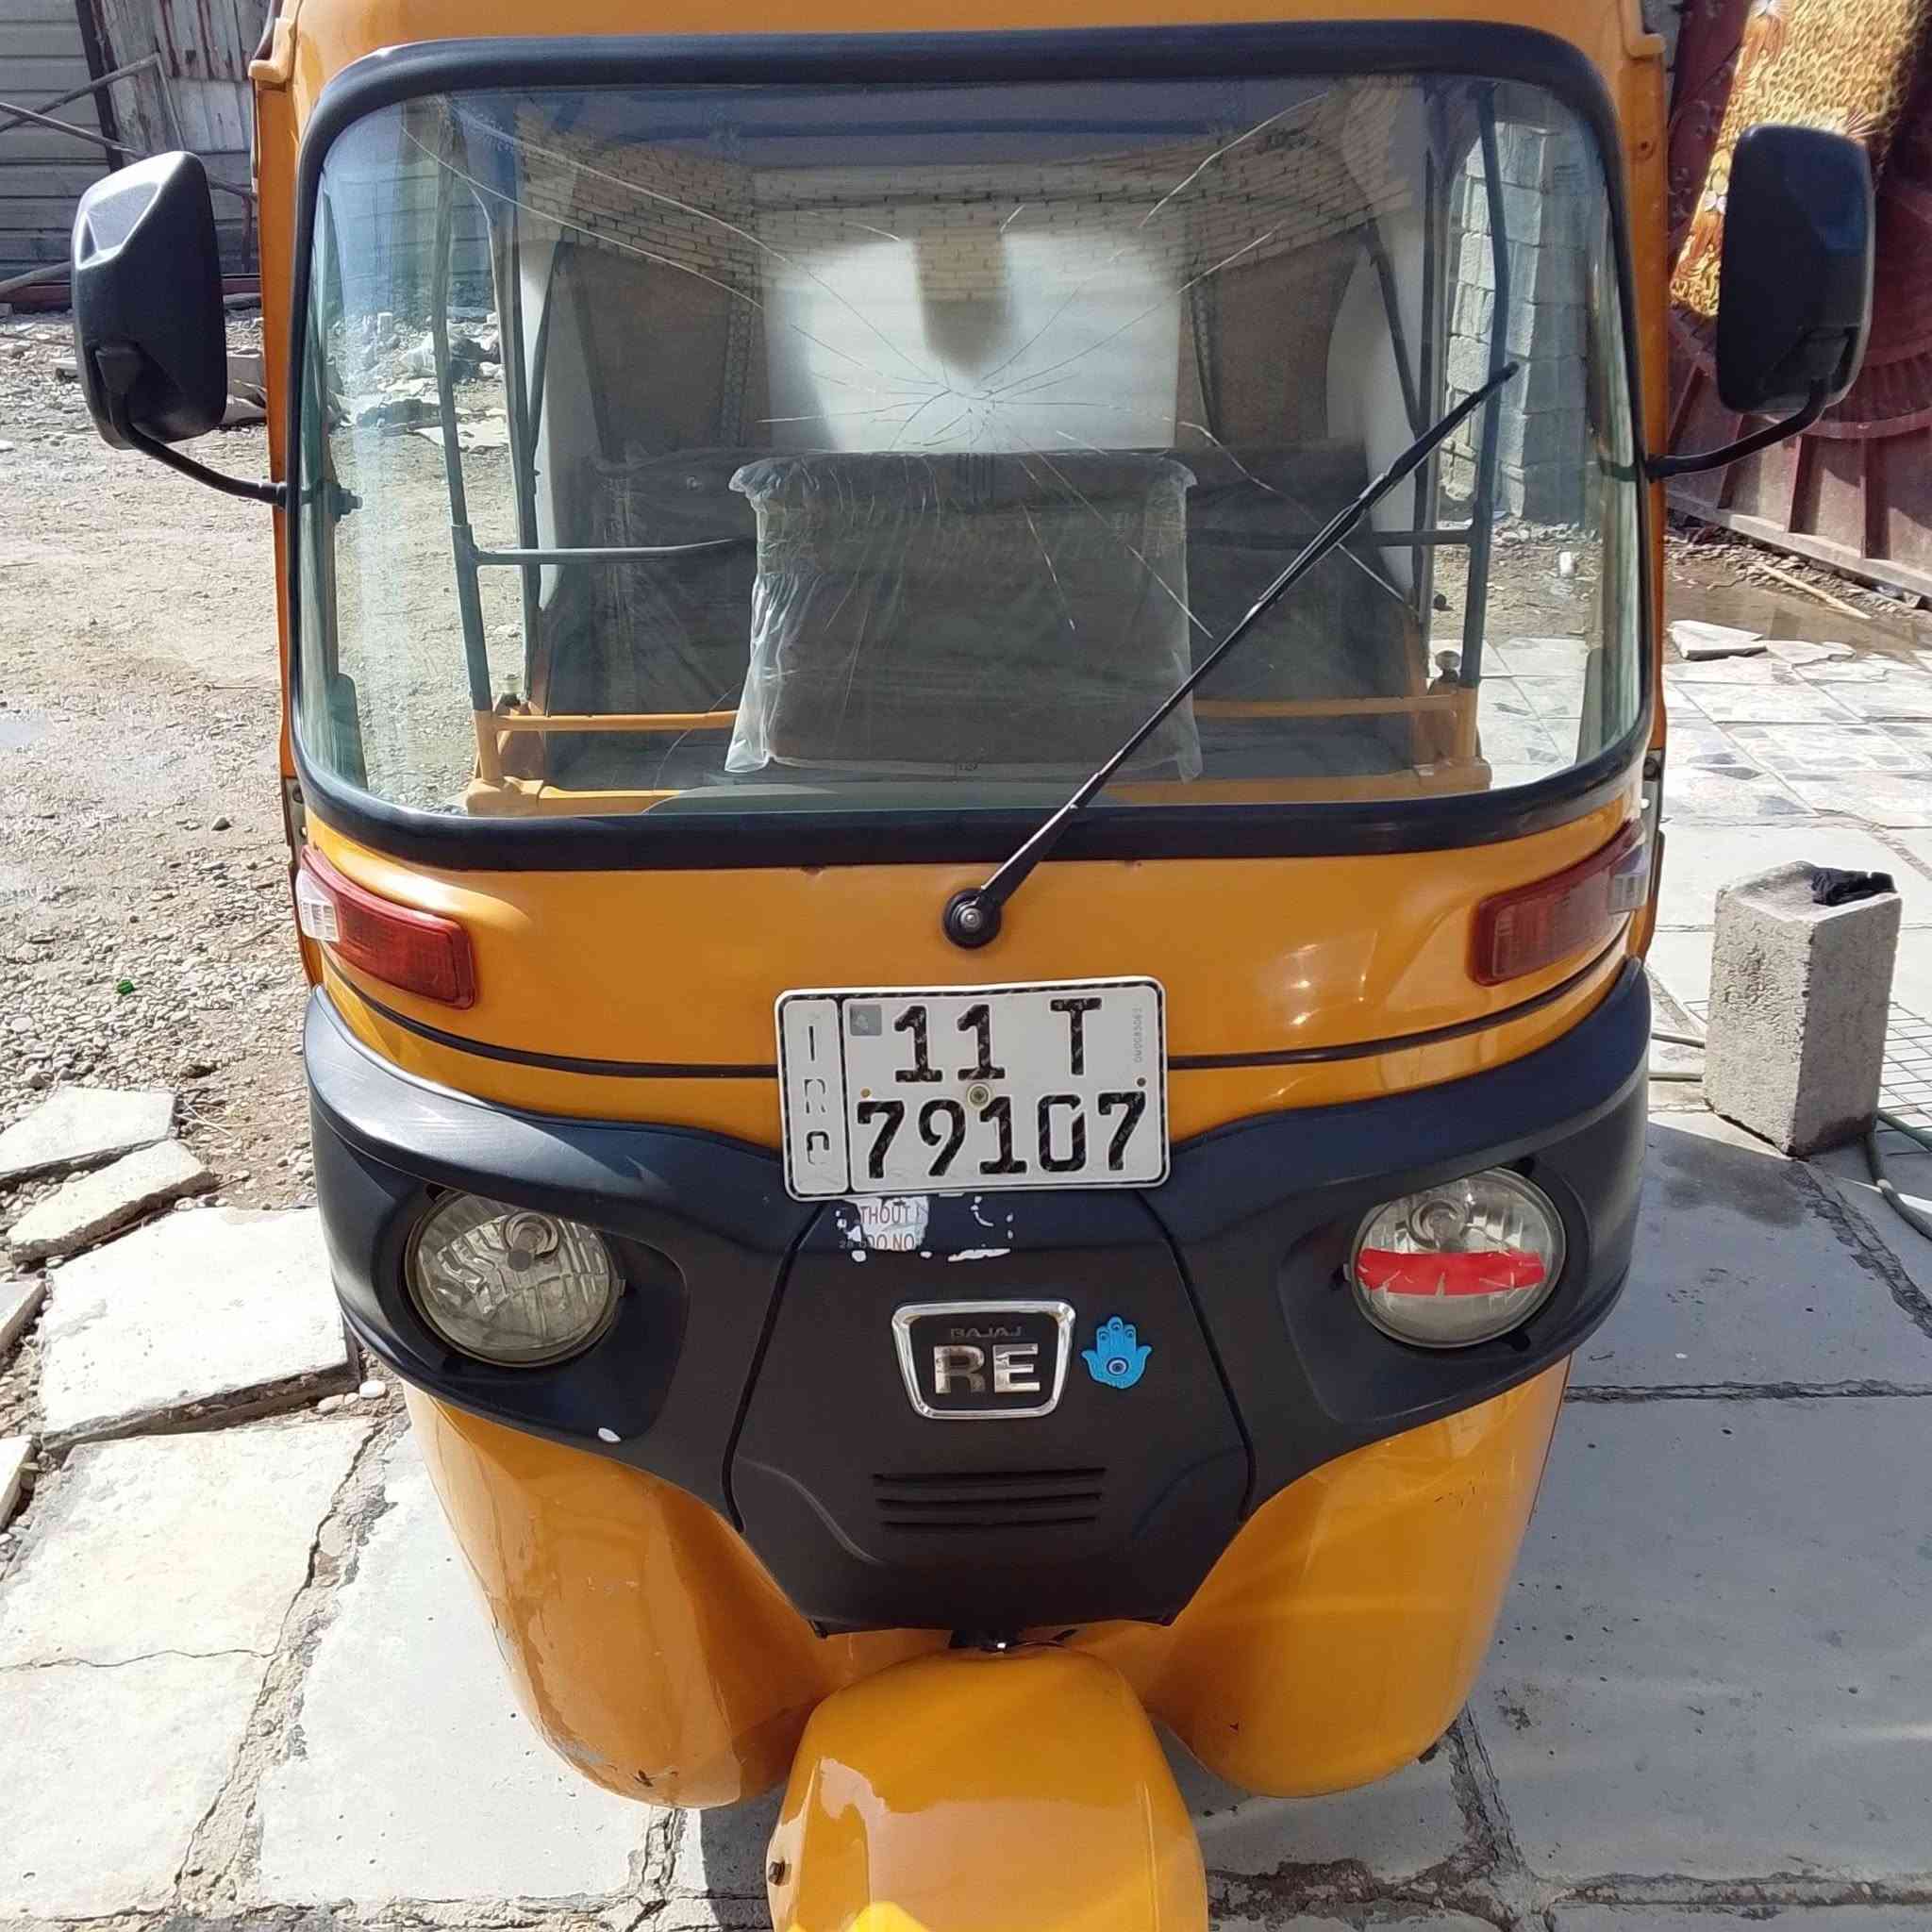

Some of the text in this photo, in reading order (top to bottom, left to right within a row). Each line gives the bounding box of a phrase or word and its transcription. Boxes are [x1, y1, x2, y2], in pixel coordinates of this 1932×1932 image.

[893, 1004, 1006, 1083] 11
[1050, 997, 1103, 1076] T
[857, 1091, 1146, 1179] 79107
[950, 1325, 1023, 1339] BAJAJ
[933, 1342, 1041, 1394] RE
